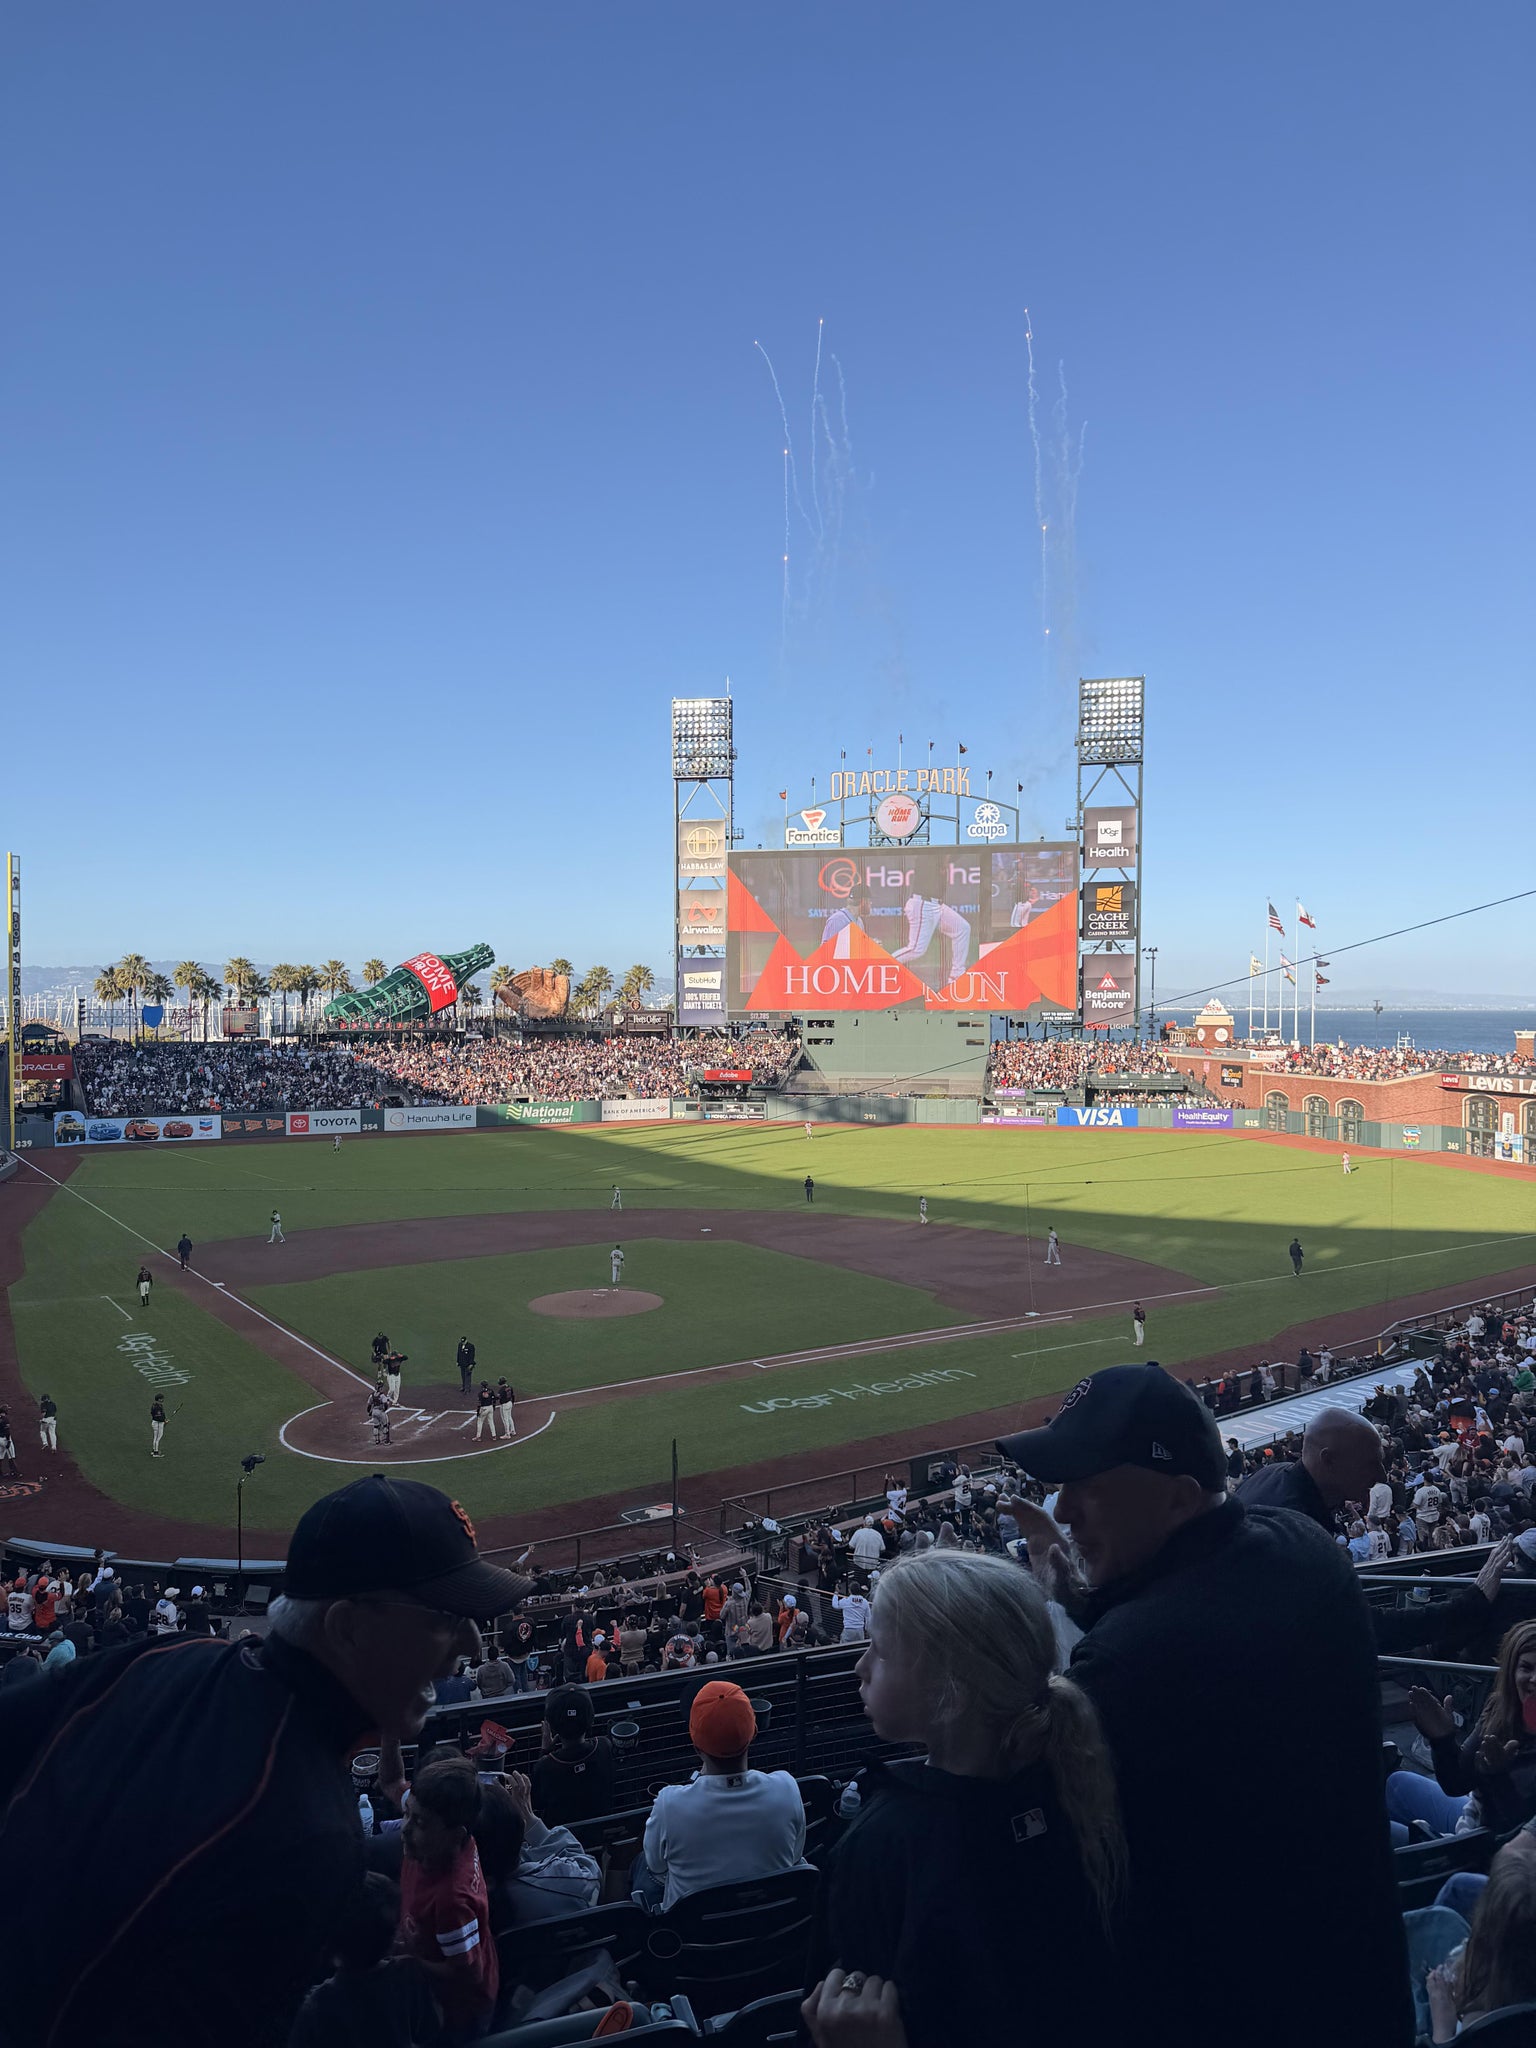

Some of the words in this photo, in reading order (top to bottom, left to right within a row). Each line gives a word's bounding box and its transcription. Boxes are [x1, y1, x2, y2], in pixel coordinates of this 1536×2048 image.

[831, 769, 909, 800] ORACLE
[916, 767, 971, 797] PARK
[888, 808, 912, 816] HOME
[890, 815, 909, 823] RUN
[969, 824, 1005, 837] coupa
[1100, 827, 1120, 837] UCSF
[788, 830, 839, 842] Fanatics
[1089, 847, 1129, 858] Health
[1088, 913, 1130, 921] CACHE
[682, 926, 723, 935] Airwallex
[1089, 921, 1128, 930] CREEK
[688, 976, 717, 984] StubHub
[784, 965, 902, 995] HOME
[685, 993, 699, 1001] 100%
[1085, 989, 1131, 1001] Benjamin
[683, 1001, 701, 1010] GIANTS
[702, 1001, 722, 1010] TICKETS
[1091, 1000, 1124, 1009] Moore
[16, 1063, 66, 1071] ORACLE
[522, 1104, 575, 1118] National
[407, 1113, 450, 1123] Hanwha
[452, 1112, 472, 1122] Life
[1072, 1109, 1123, 1126] VISA
[1178, 1112, 1226, 1122] HealthEquity
[313, 1118, 357, 1127] TOYOTA
[362, 1123, 378, 1131] 354
[15, 1140, 33, 1148] 339
[1447, 1142, 1460, 1150] 365
[125, 1350, 196, 1389] Health
[740, 1393, 835, 1414] UCSF
[828, 1369, 976, 1400] Health
[1428, 1496, 1439, 1507] 28
[10, 1603, 22, 1614] 35
